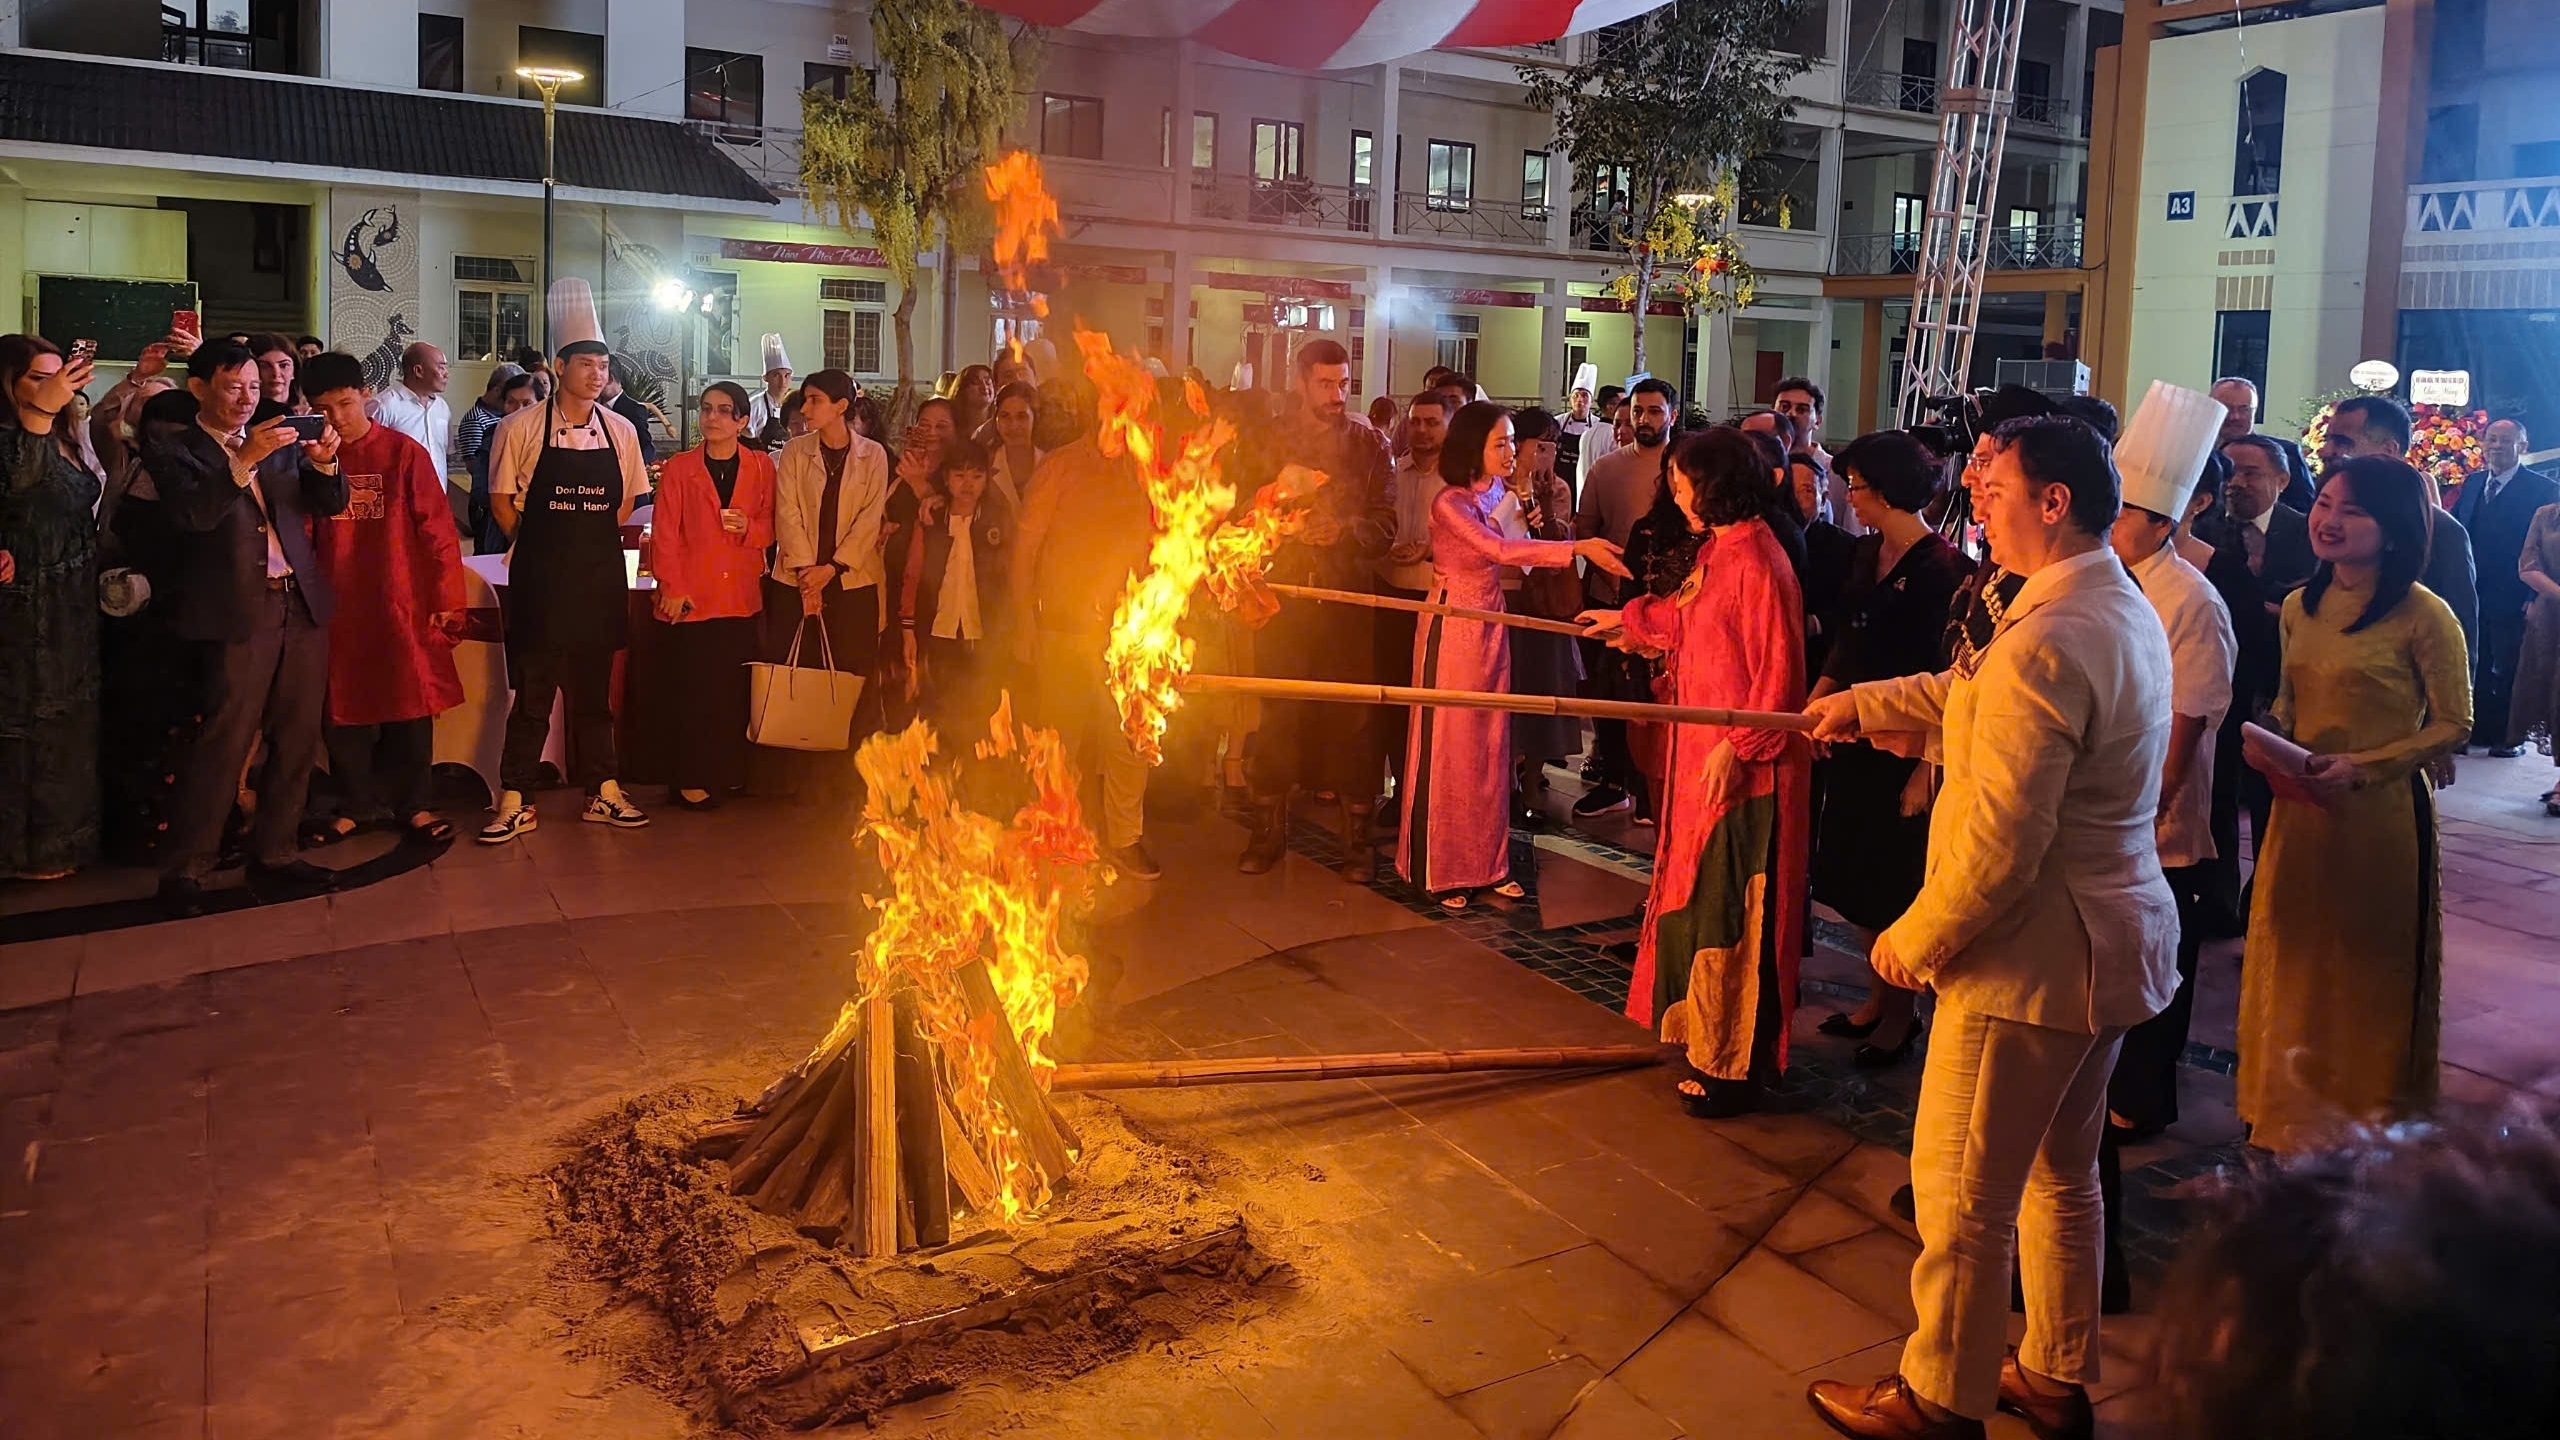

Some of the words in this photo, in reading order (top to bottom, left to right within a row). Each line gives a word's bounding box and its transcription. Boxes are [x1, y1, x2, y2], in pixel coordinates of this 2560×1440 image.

[2170, 197, 2190, 214] A3
[555, 485, 576, 495] Don
[578, 485, 605, 495] David
[549, 500, 576, 511] Baku
